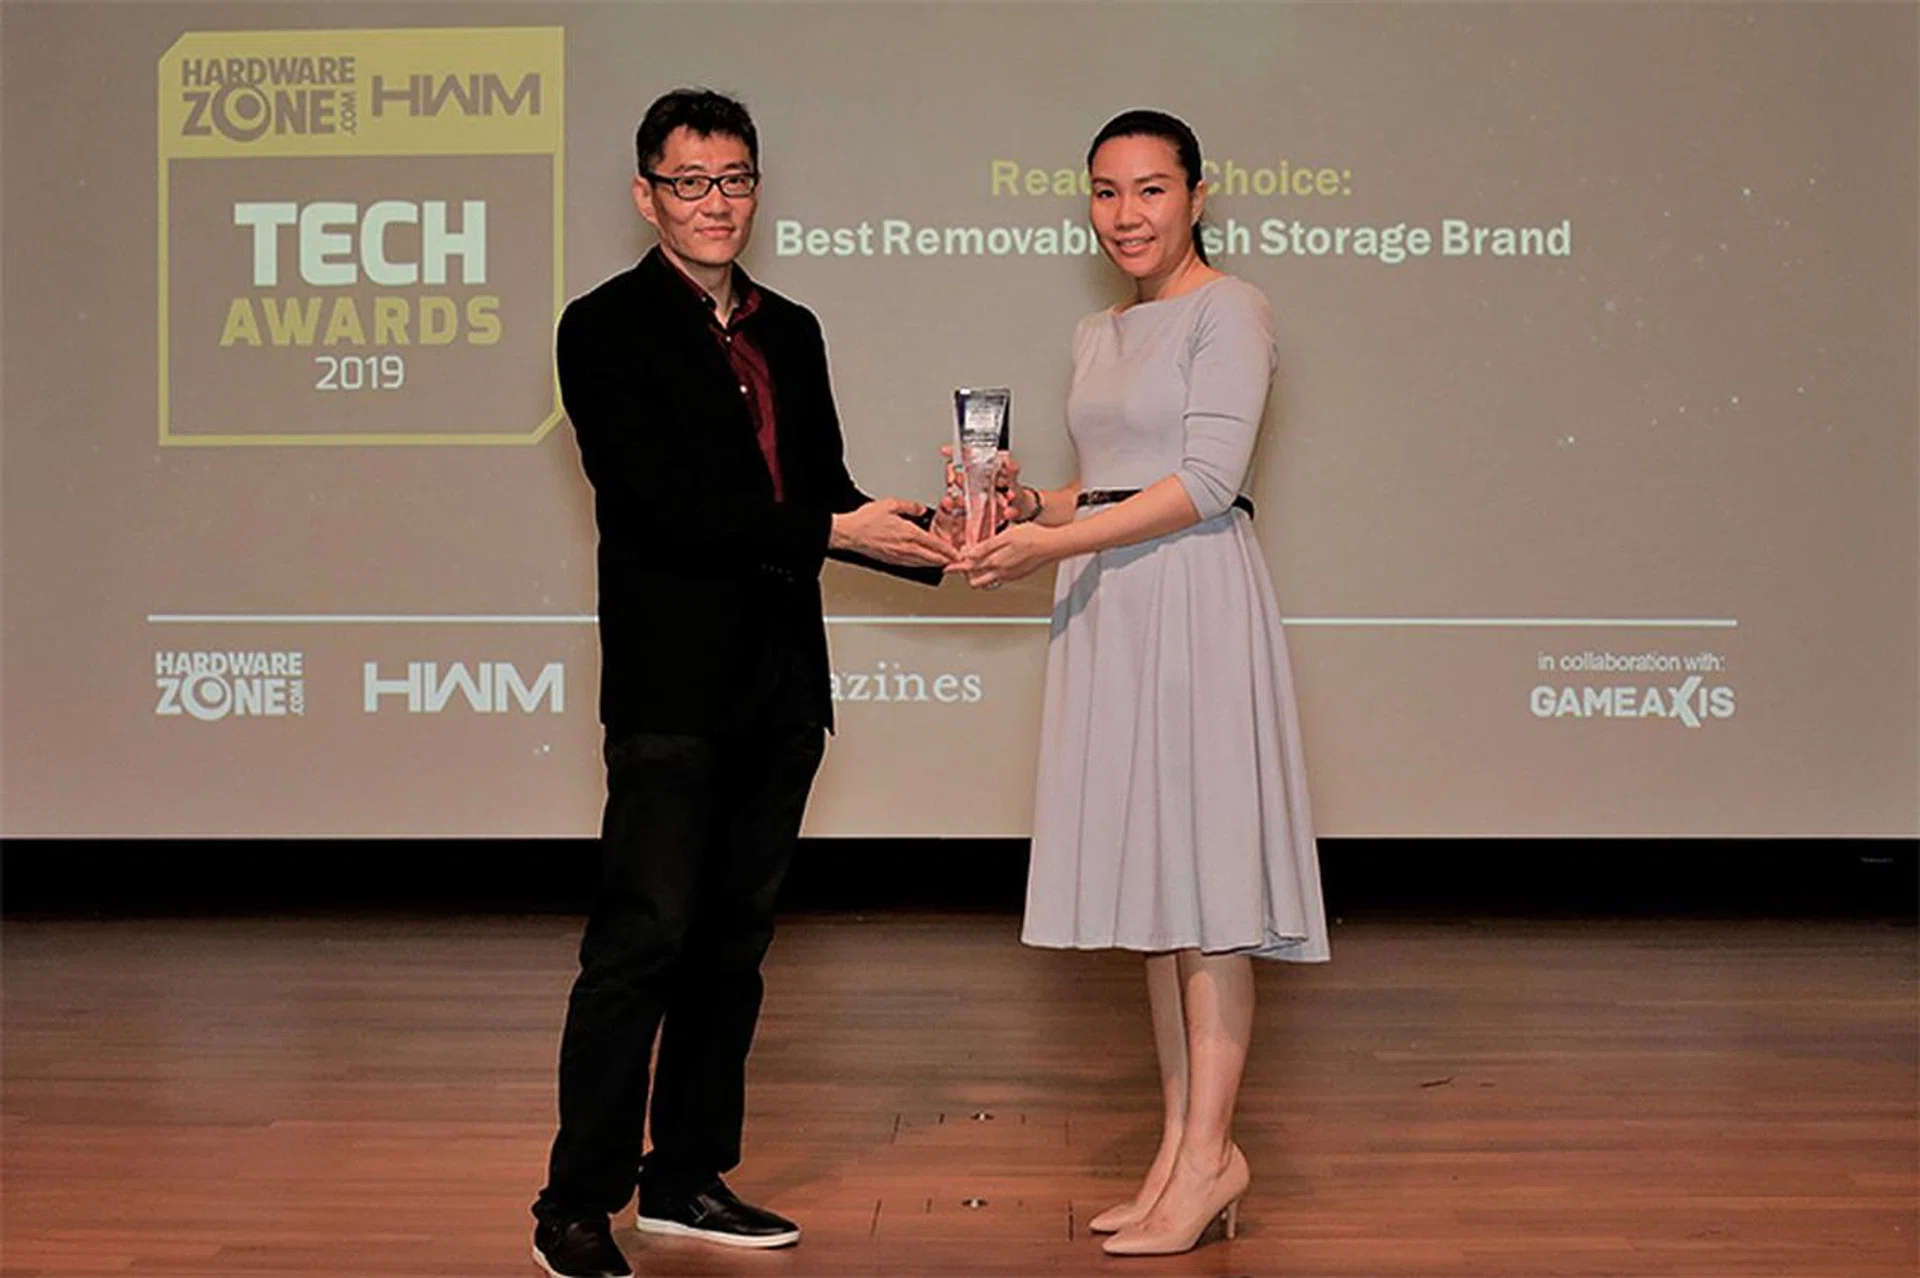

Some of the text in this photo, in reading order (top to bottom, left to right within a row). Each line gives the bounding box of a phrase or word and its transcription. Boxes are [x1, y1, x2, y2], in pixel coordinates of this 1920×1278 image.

[182, 57, 356, 86] HARDWARE
[182, 84, 336, 142] ZONE
[370, 73, 541, 117] HWM
[1203, 159, 1353, 195] Choice:
[234, 200, 487, 287] TECH
[776, 220, 874, 255] Best
[882, 218, 1098, 255] Removabl
[1260, 218, 1432, 264] Storage
[1442, 219, 1572, 256] Brand
[219, 295, 502, 348] AWARDS
[314, 355, 405, 390] 2019
[155, 652, 303, 675] HARDWARE
[830, 660, 982, 702] azines
[1538, 651, 1555, 670] in
[1560, 652, 1681, 671] collaboration
[155, 672, 287, 721] ZONE
[364, 662, 564, 713] HWM
[1530, 675, 1736, 728] GAMEAXIS
